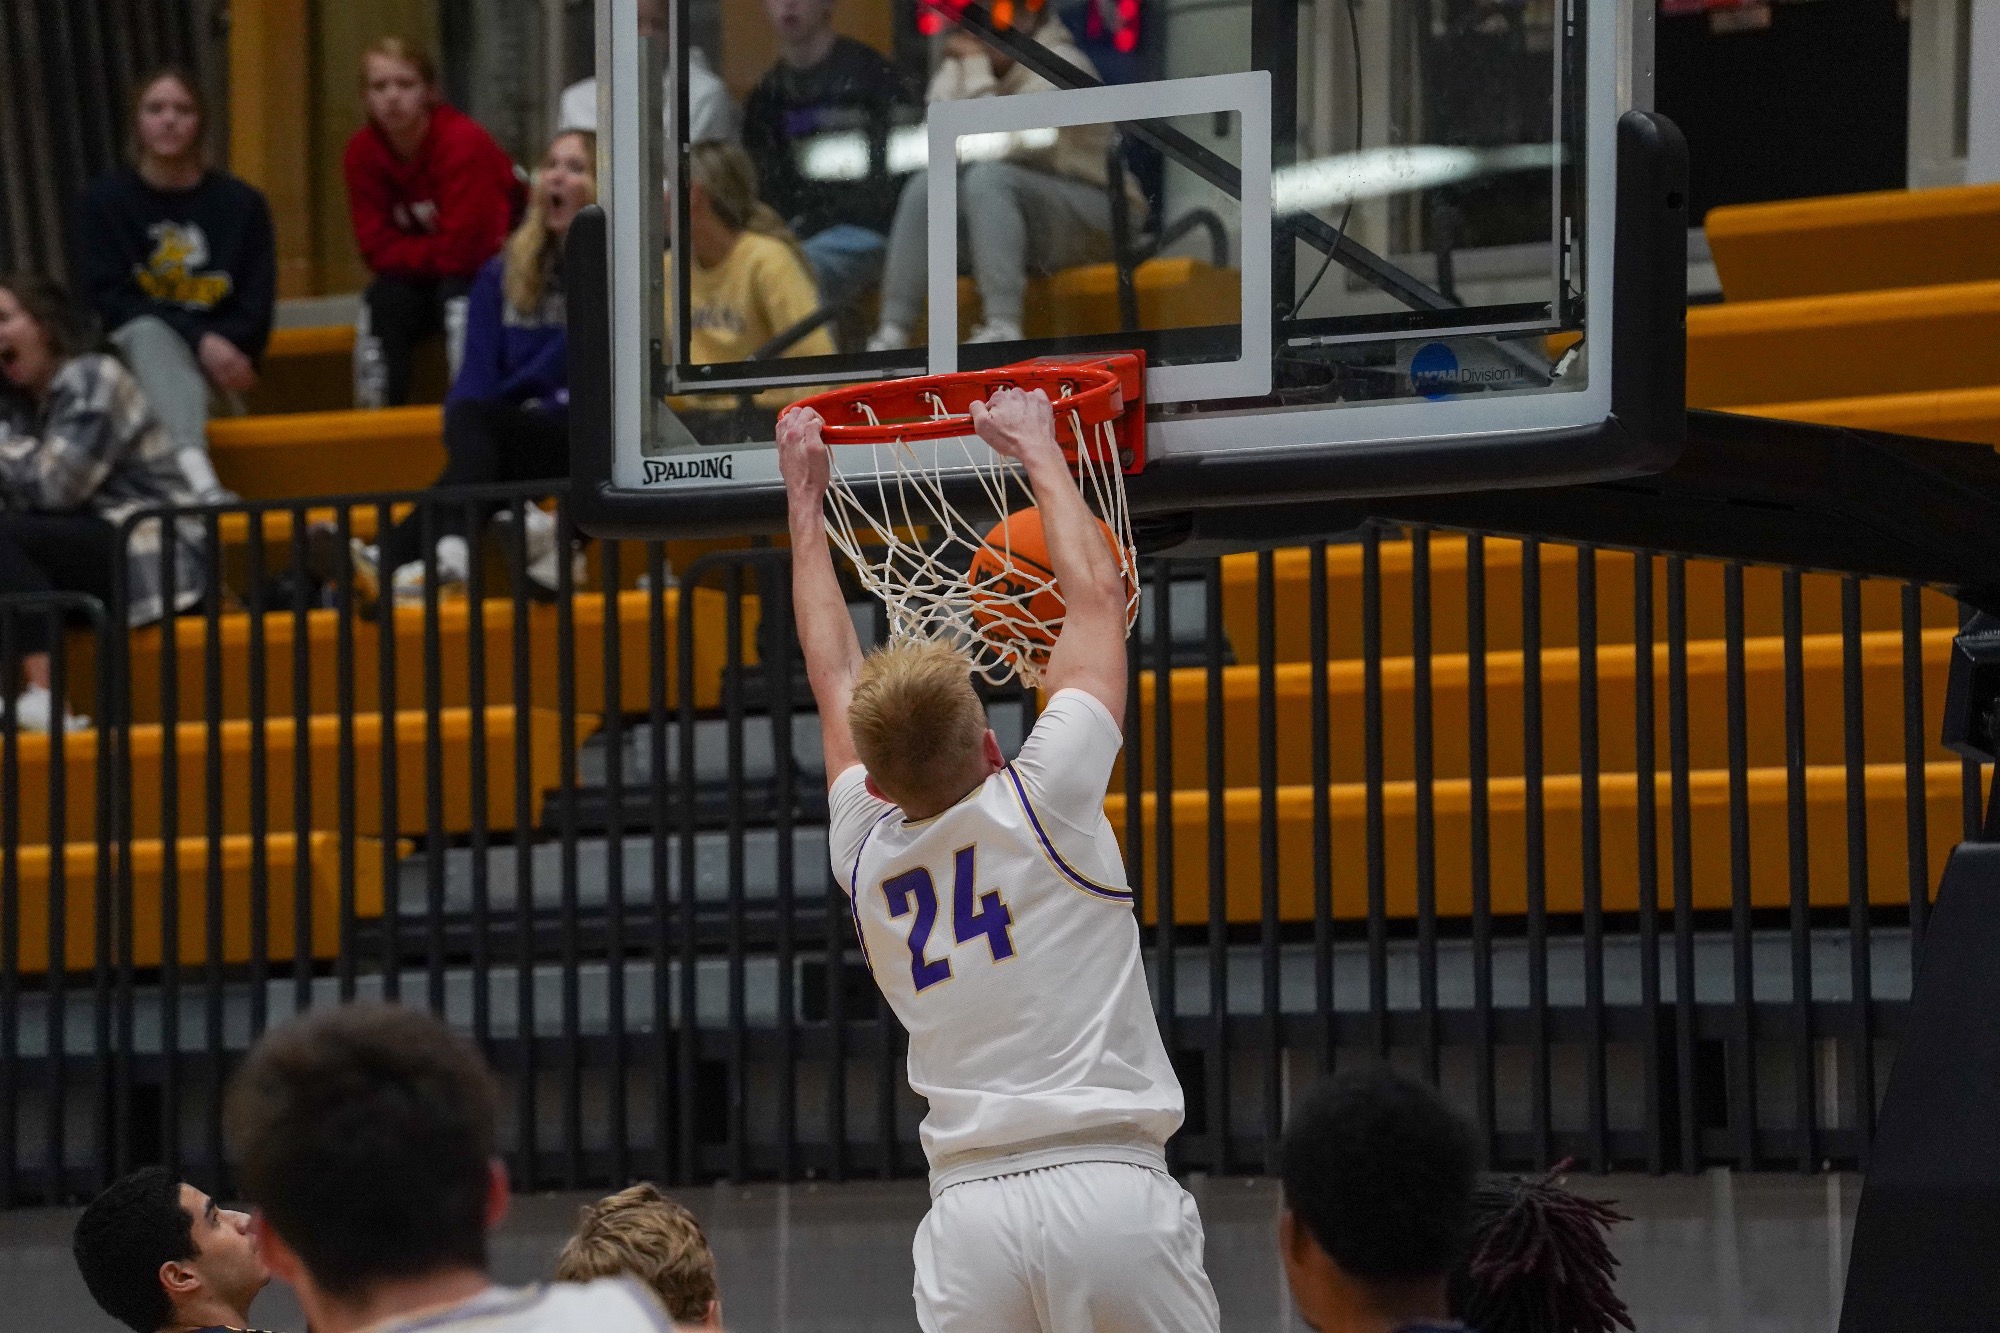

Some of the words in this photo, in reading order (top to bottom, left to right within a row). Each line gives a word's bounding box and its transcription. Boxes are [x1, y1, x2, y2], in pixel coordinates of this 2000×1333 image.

[1461, 367, 1510, 383] Division
[1514, 364, 1524, 378] III
[643, 455, 732, 485] SPALDING
[880, 841, 1018, 995] 24
